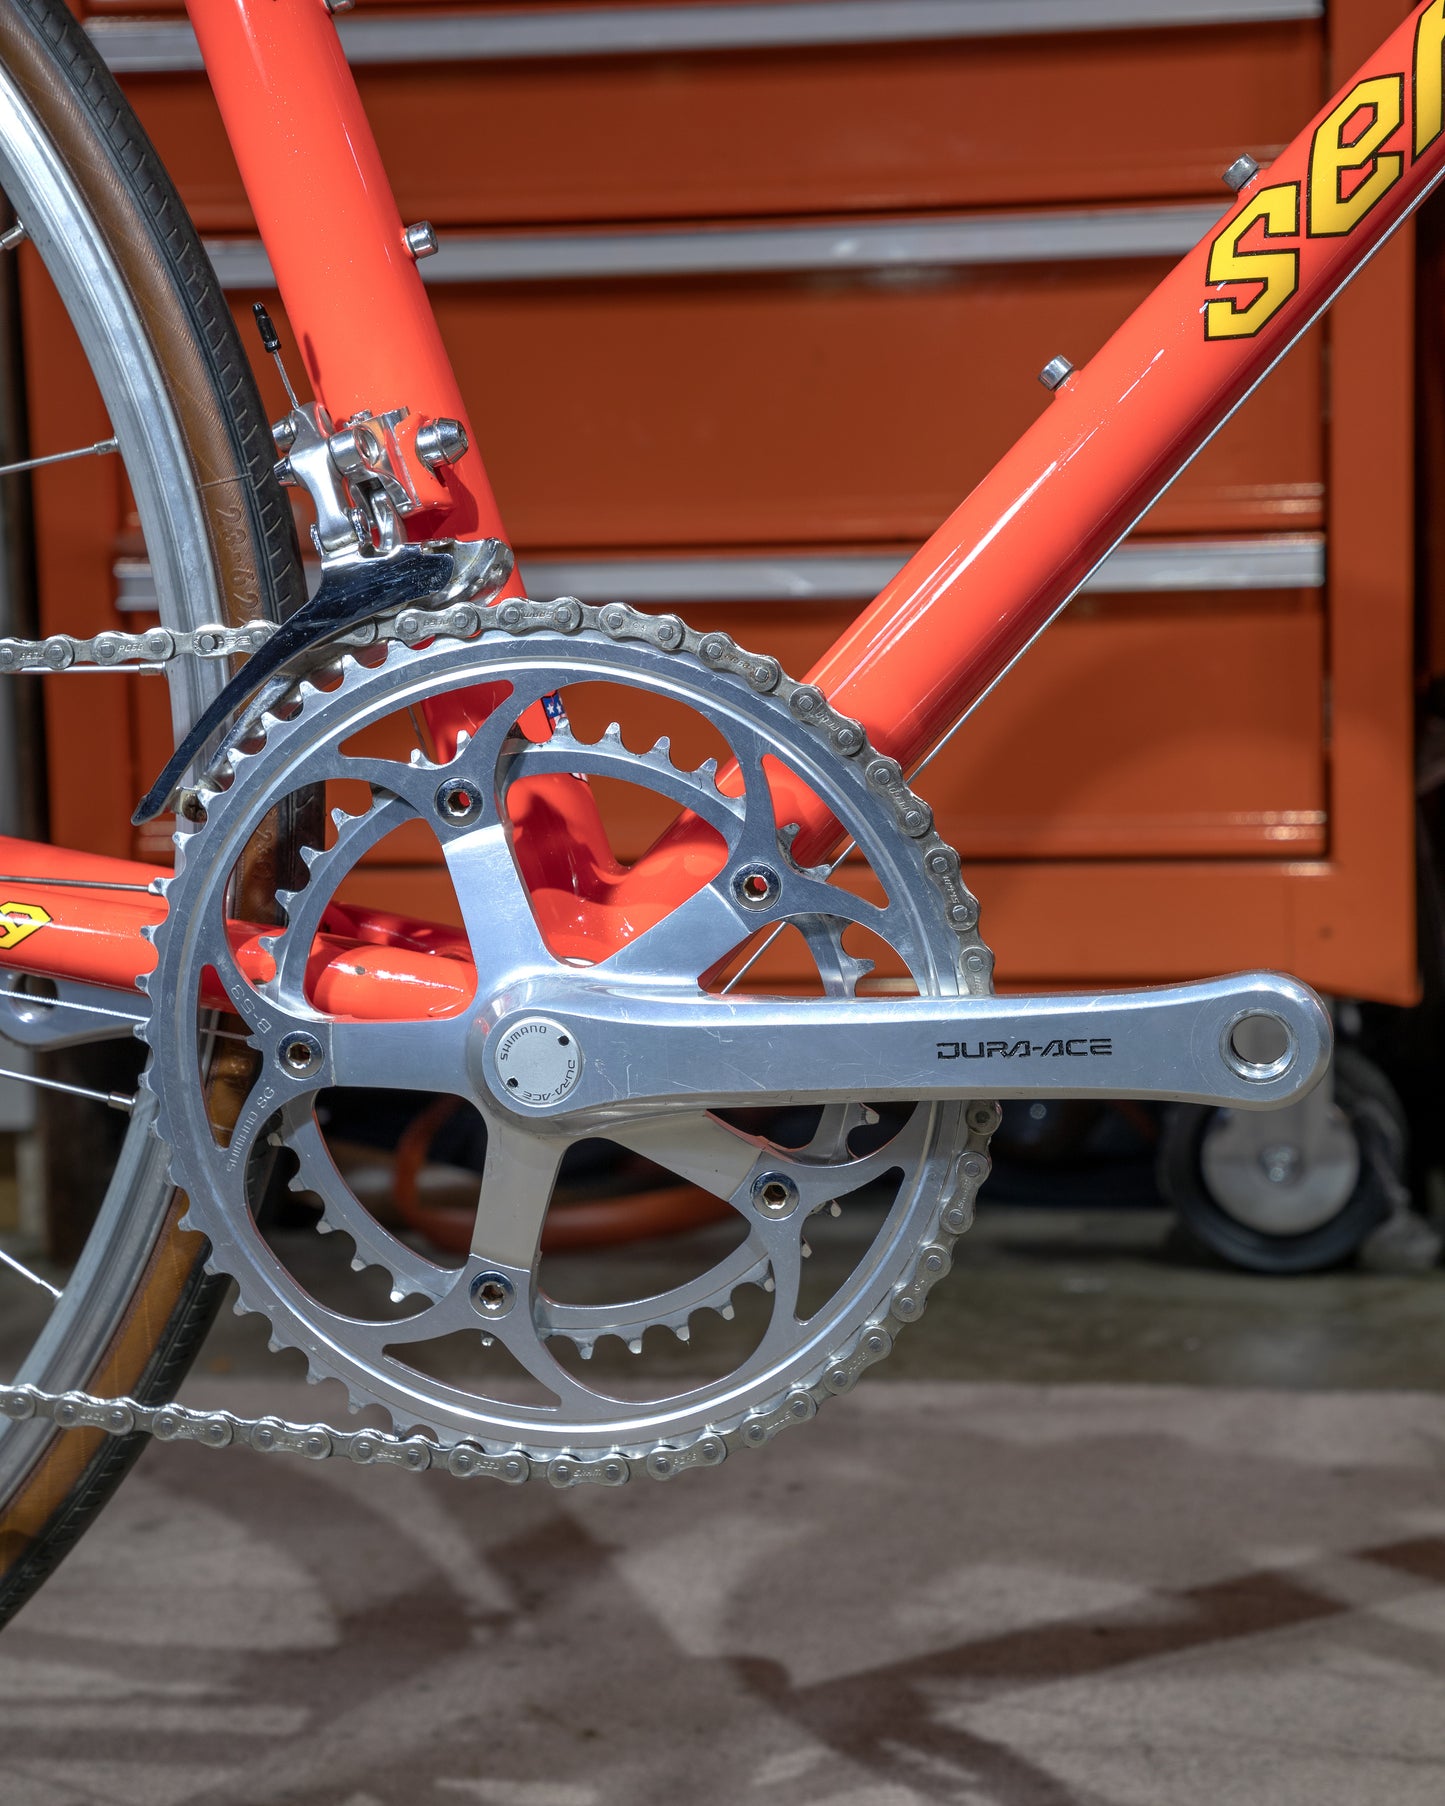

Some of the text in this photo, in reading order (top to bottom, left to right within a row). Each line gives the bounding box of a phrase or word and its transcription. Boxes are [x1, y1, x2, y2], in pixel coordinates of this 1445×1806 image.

[231, 984, 273, 1034] B-53
[500, 1025, 547, 1061] SHIMANO
[936, 1038, 1112, 1060] DURA-ACE
[257, 1085, 276, 1110] SG
[522, 1059, 576, 1101] DURA-ACE
